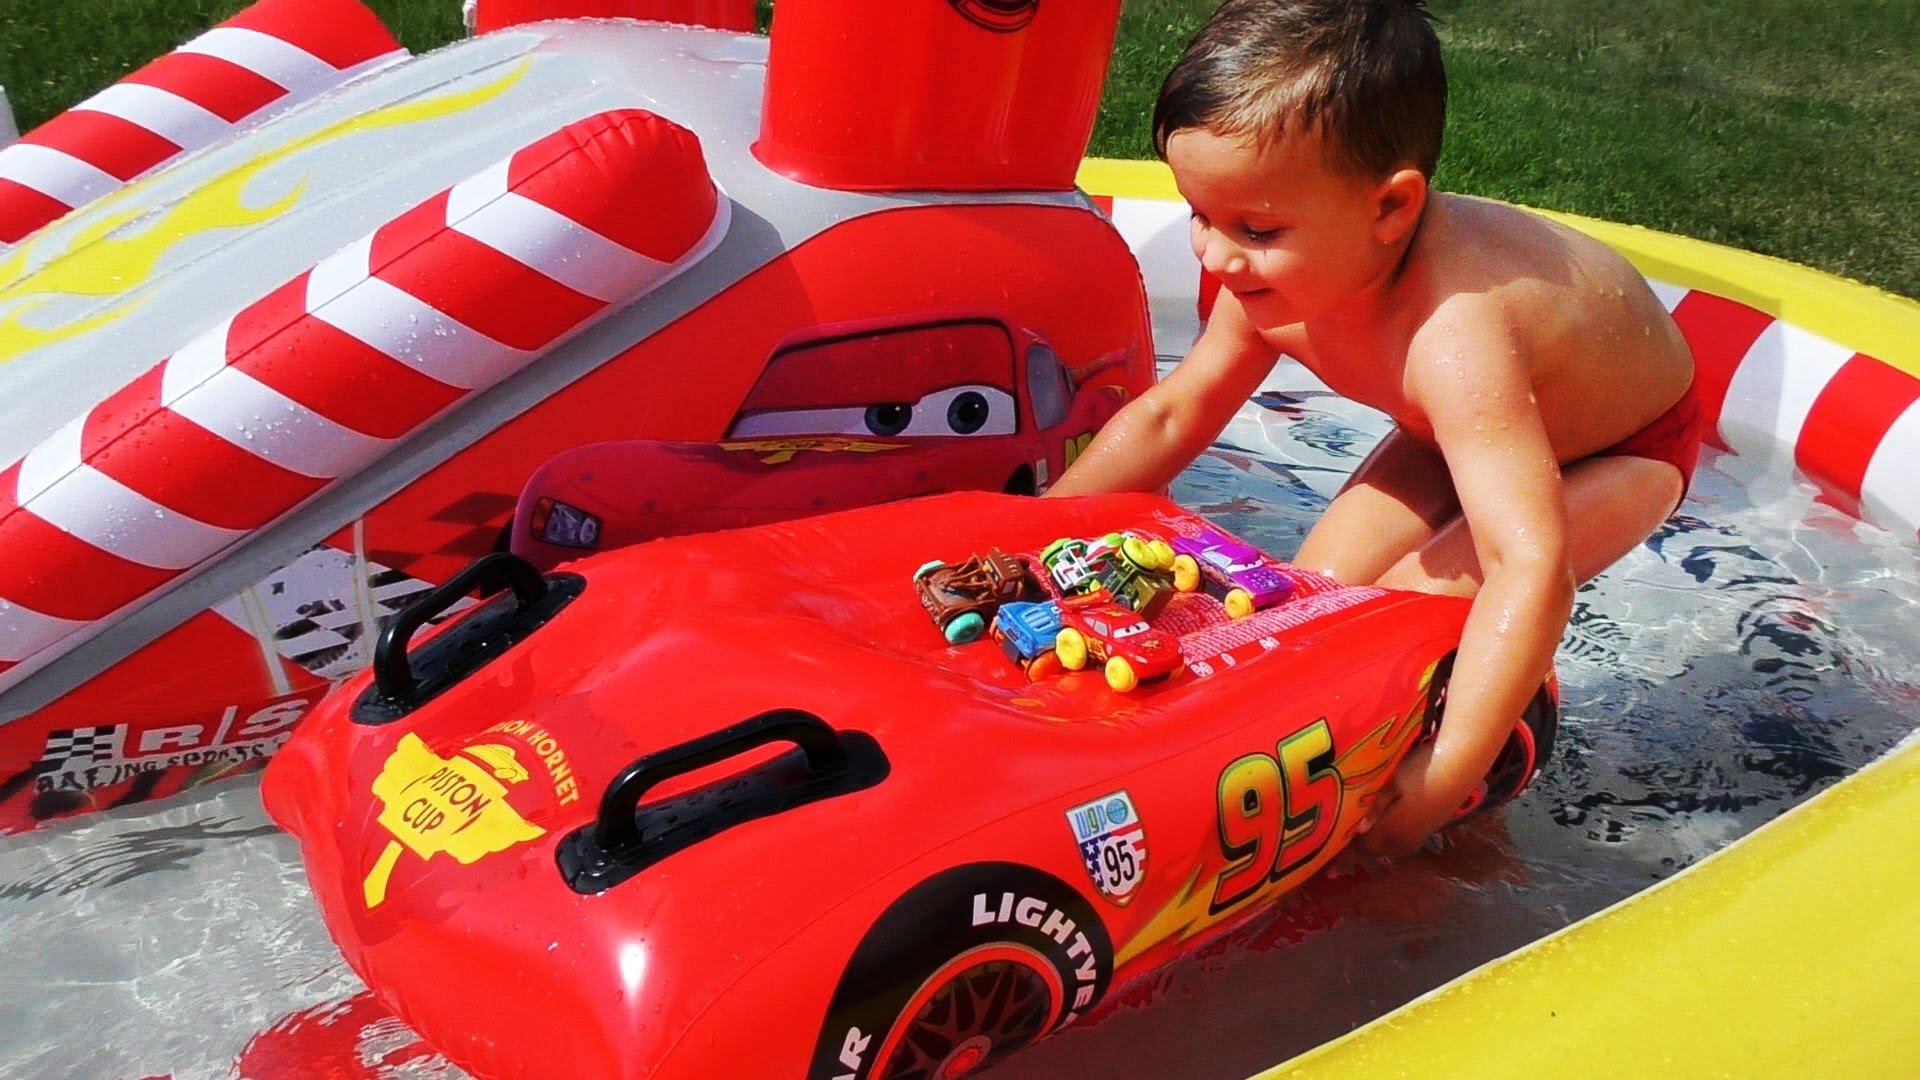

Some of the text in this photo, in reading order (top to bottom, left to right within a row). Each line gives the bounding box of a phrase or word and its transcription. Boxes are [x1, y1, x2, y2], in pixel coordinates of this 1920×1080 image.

[422, 766, 492, 818] PISTON
[527, 729, 579, 806] HORNET
[402, 797, 446, 835] CUP
[1208, 717, 1344, 916] 95
[1103, 839, 1136, 887] 95
[831, 1026, 872, 1080] R
